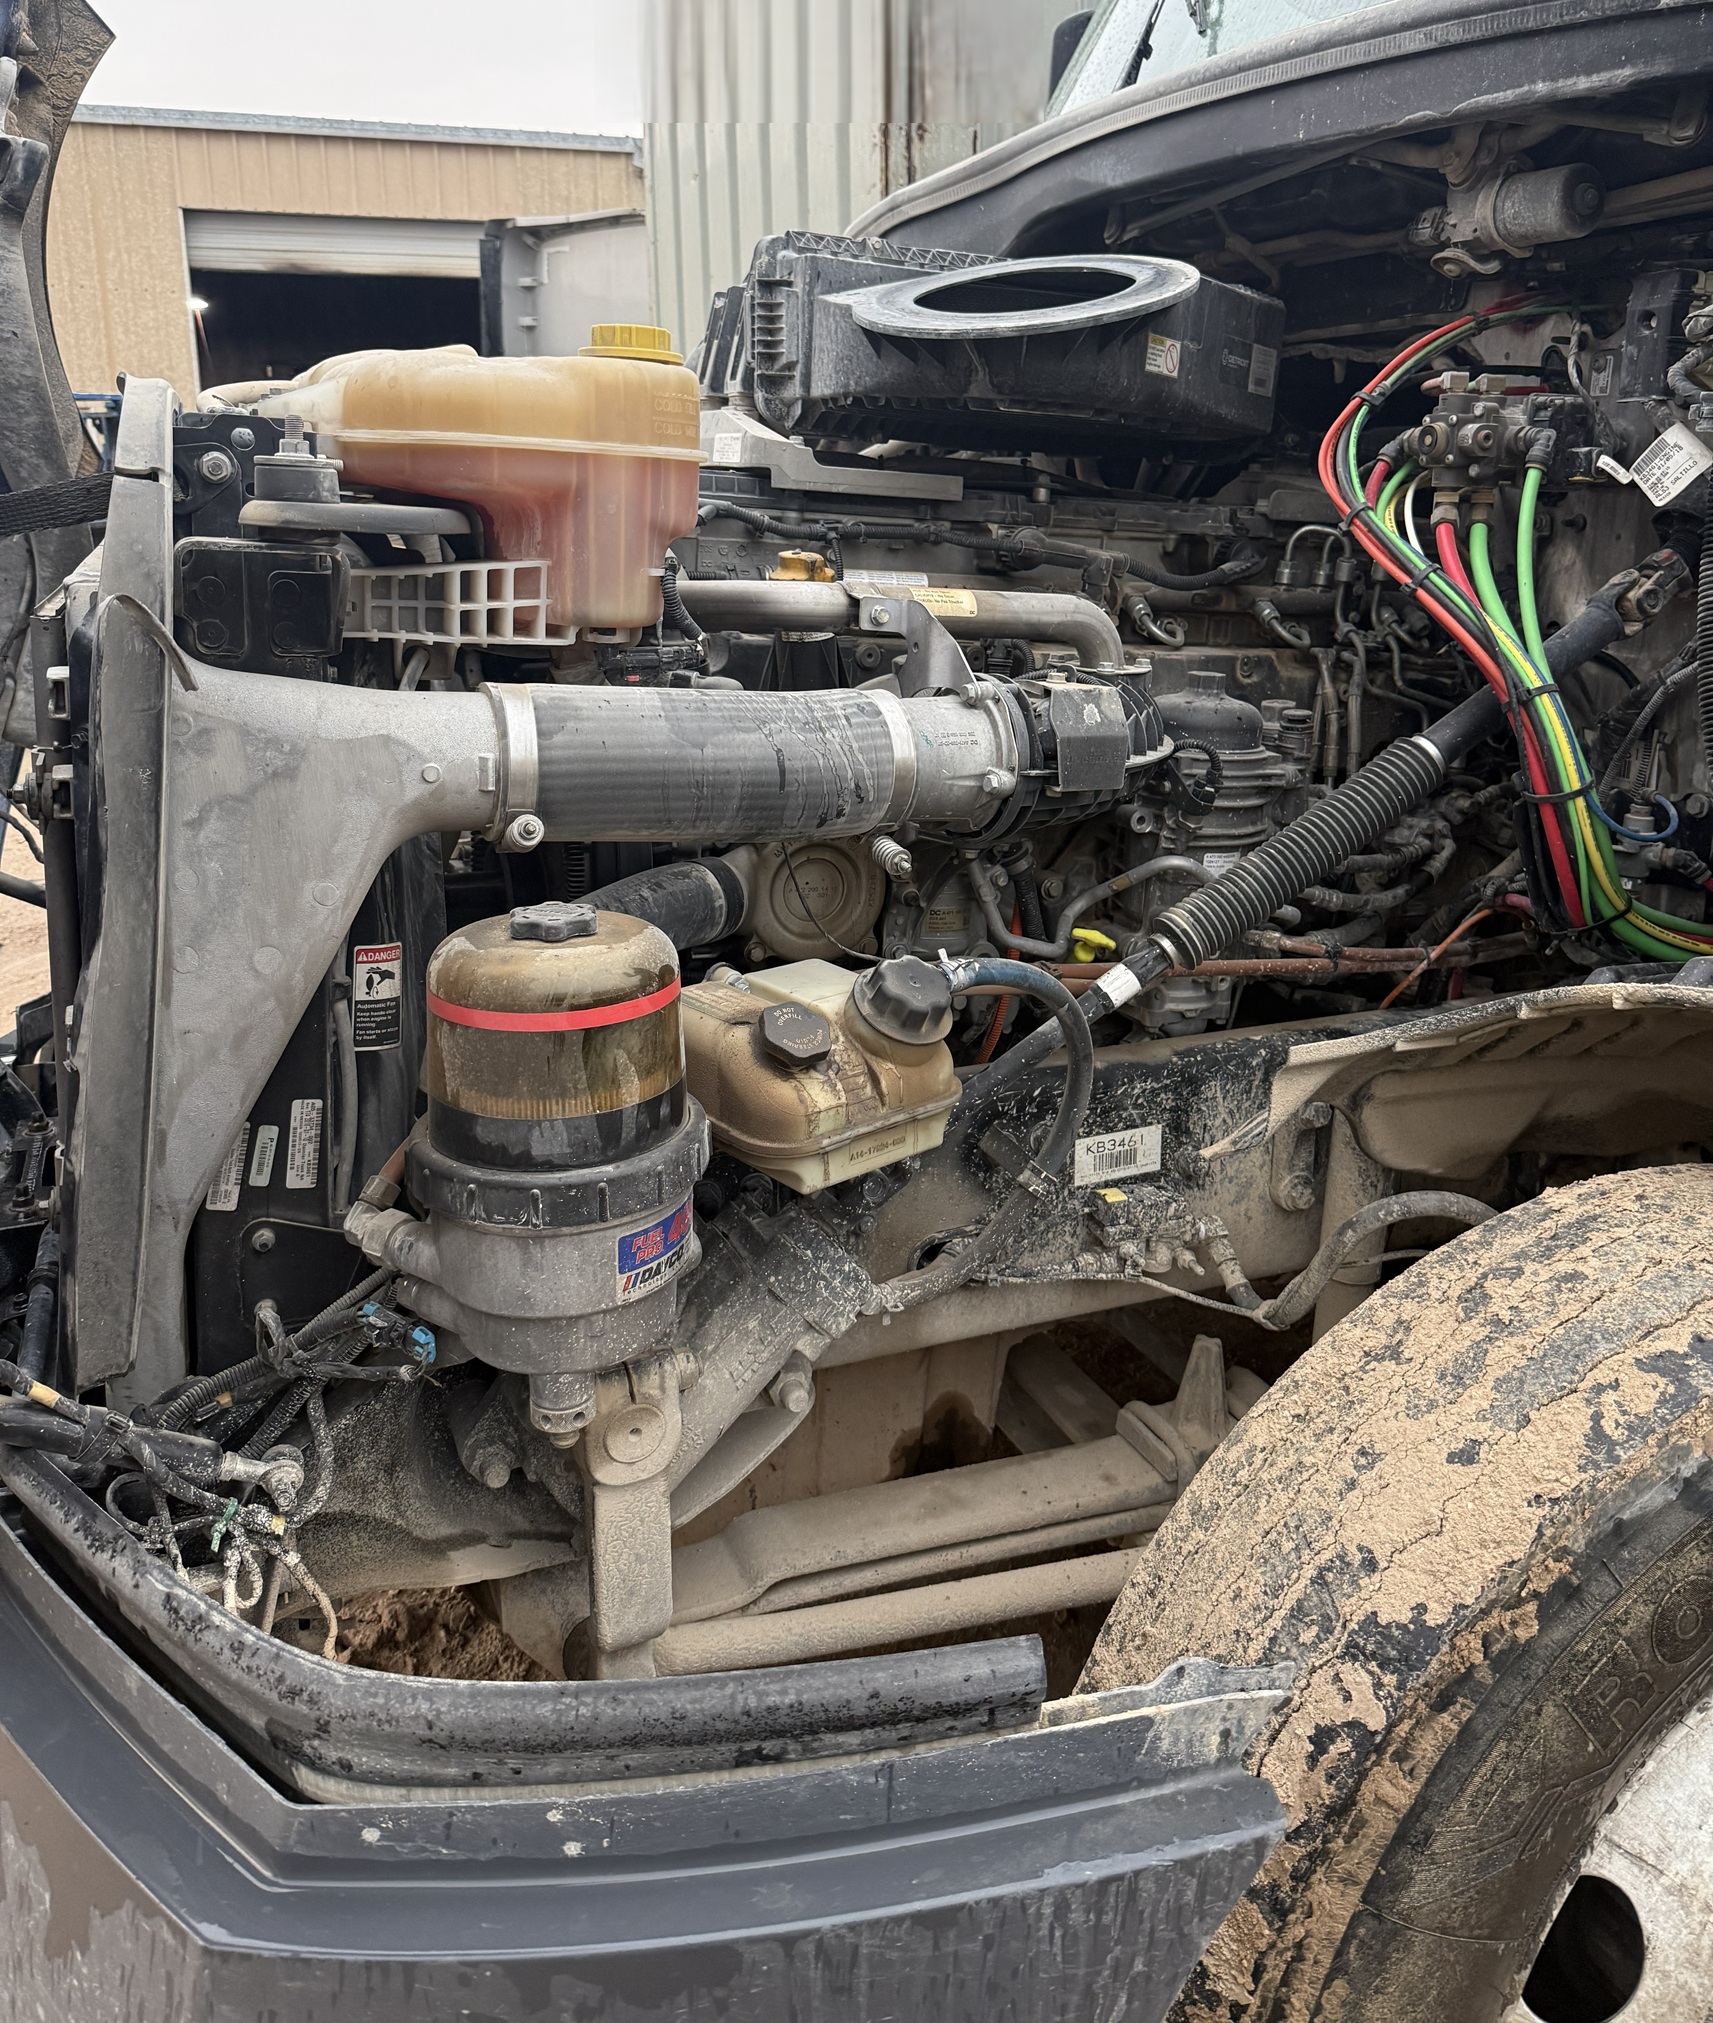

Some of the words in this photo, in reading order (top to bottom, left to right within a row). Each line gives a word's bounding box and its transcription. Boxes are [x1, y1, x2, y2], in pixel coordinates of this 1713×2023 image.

[1670, 460, 1698, 486] SALTILLO
[368, 949, 400, 960] DANGER
[357, 1001, 386, 1009] Automatic
[778, 1013, 802, 1026] OVERFILL
[1086, 1134, 1144, 1155] KB3461
[631, 1226, 665, 1252] FUEL
[635, 1241, 664, 1265] PRO
